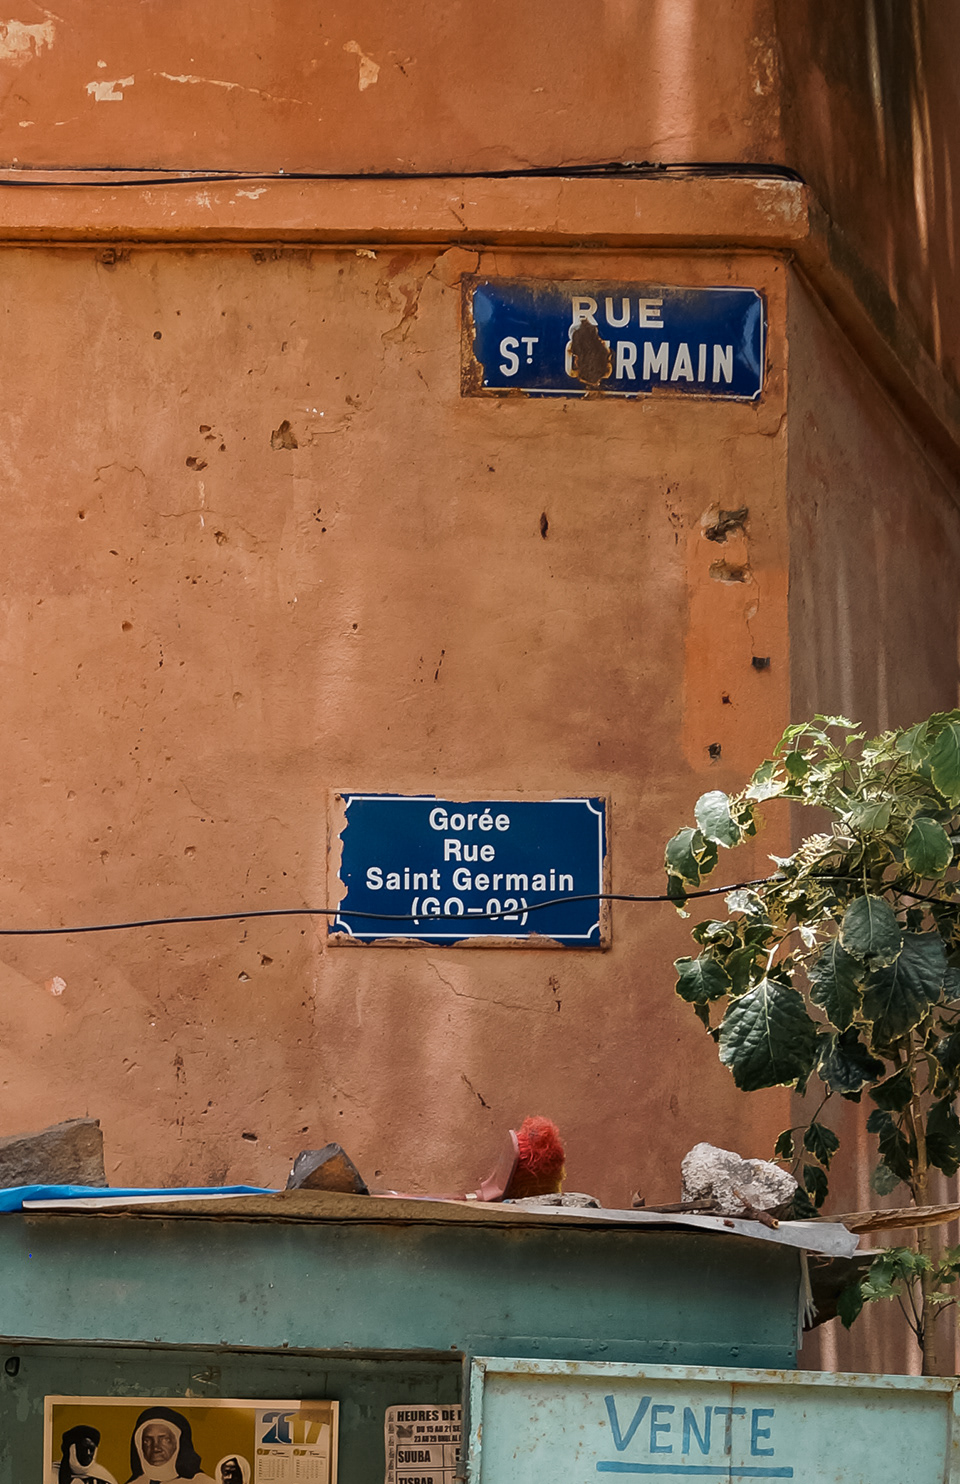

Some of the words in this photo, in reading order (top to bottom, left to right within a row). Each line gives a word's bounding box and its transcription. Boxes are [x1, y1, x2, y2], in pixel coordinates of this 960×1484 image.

[571, 296, 665, 329] RUE
[564, 340, 734, 384] RMAIN
[428, 807, 511, 832] Gorée
[443, 838, 496, 862] Rue
[365, 866, 442, 890] Saint
[452, 867, 575, 892] Germain
[396, 1410, 439, 1422] HEURES
[441, 1409, 456, 1421] DE
[603, 1394, 776, 1457] VENTE
[397, 1450, 431, 1463] SUUBA
